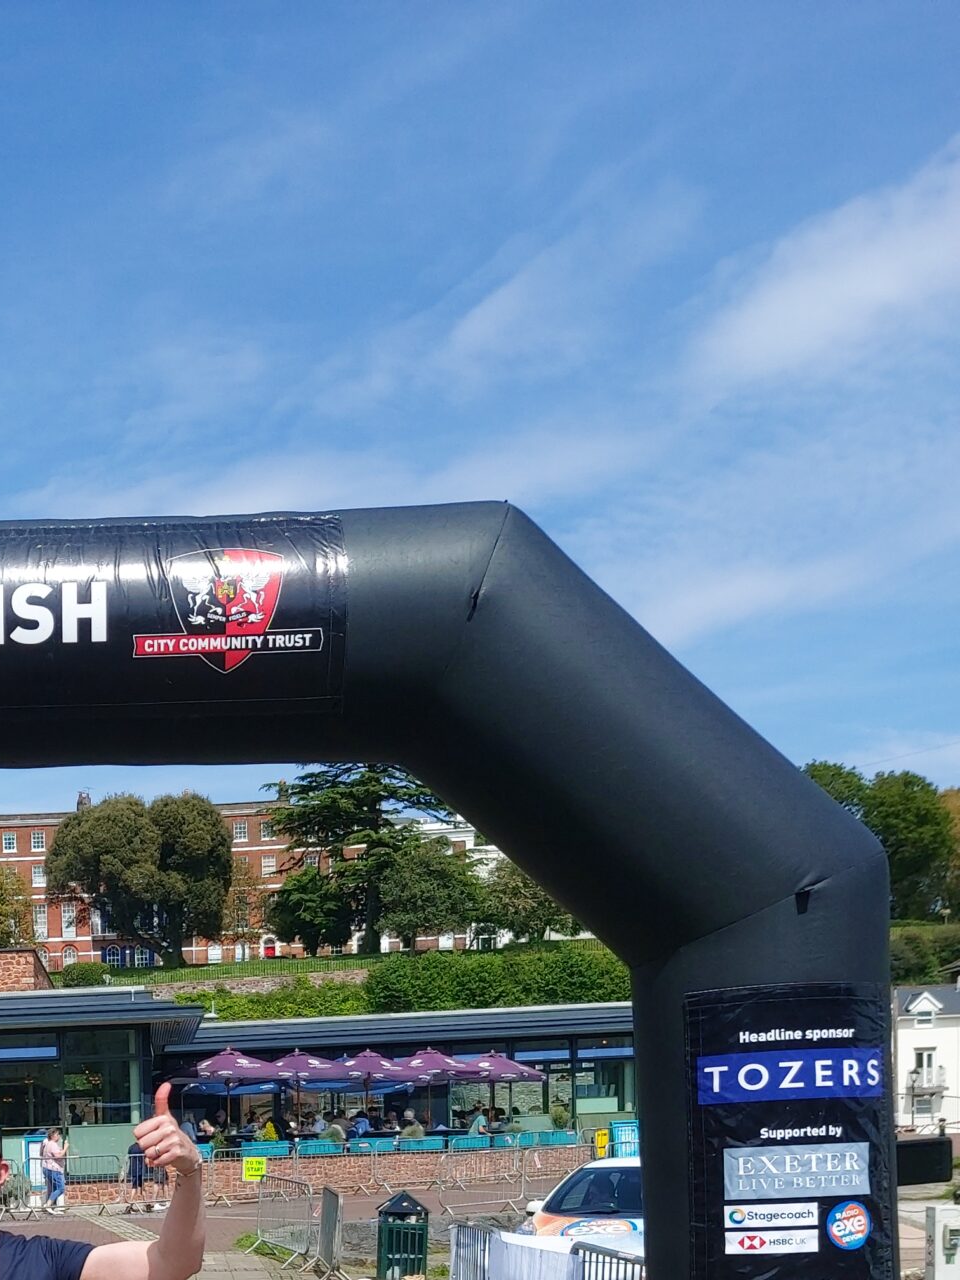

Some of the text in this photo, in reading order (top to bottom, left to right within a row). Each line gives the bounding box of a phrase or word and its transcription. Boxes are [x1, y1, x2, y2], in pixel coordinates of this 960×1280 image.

[144, 633, 313, 652] CITY COMMUNITY TRUST
[739, 1028, 856, 1044] Headline sponsor
[703, 1058, 880, 1093] TOZERS
[760, 1124, 843, 1140] Supported by
[737, 1151, 861, 1176] EXETER
[738, 1173, 862, 1191] LIVE BETTER
[746, 1209, 815, 1222] Stagecoach
[567, 1224, 628, 1236] exe
[831, 1215, 866, 1237] exe
[768, 1237, 807, 1246] HSBC UK
